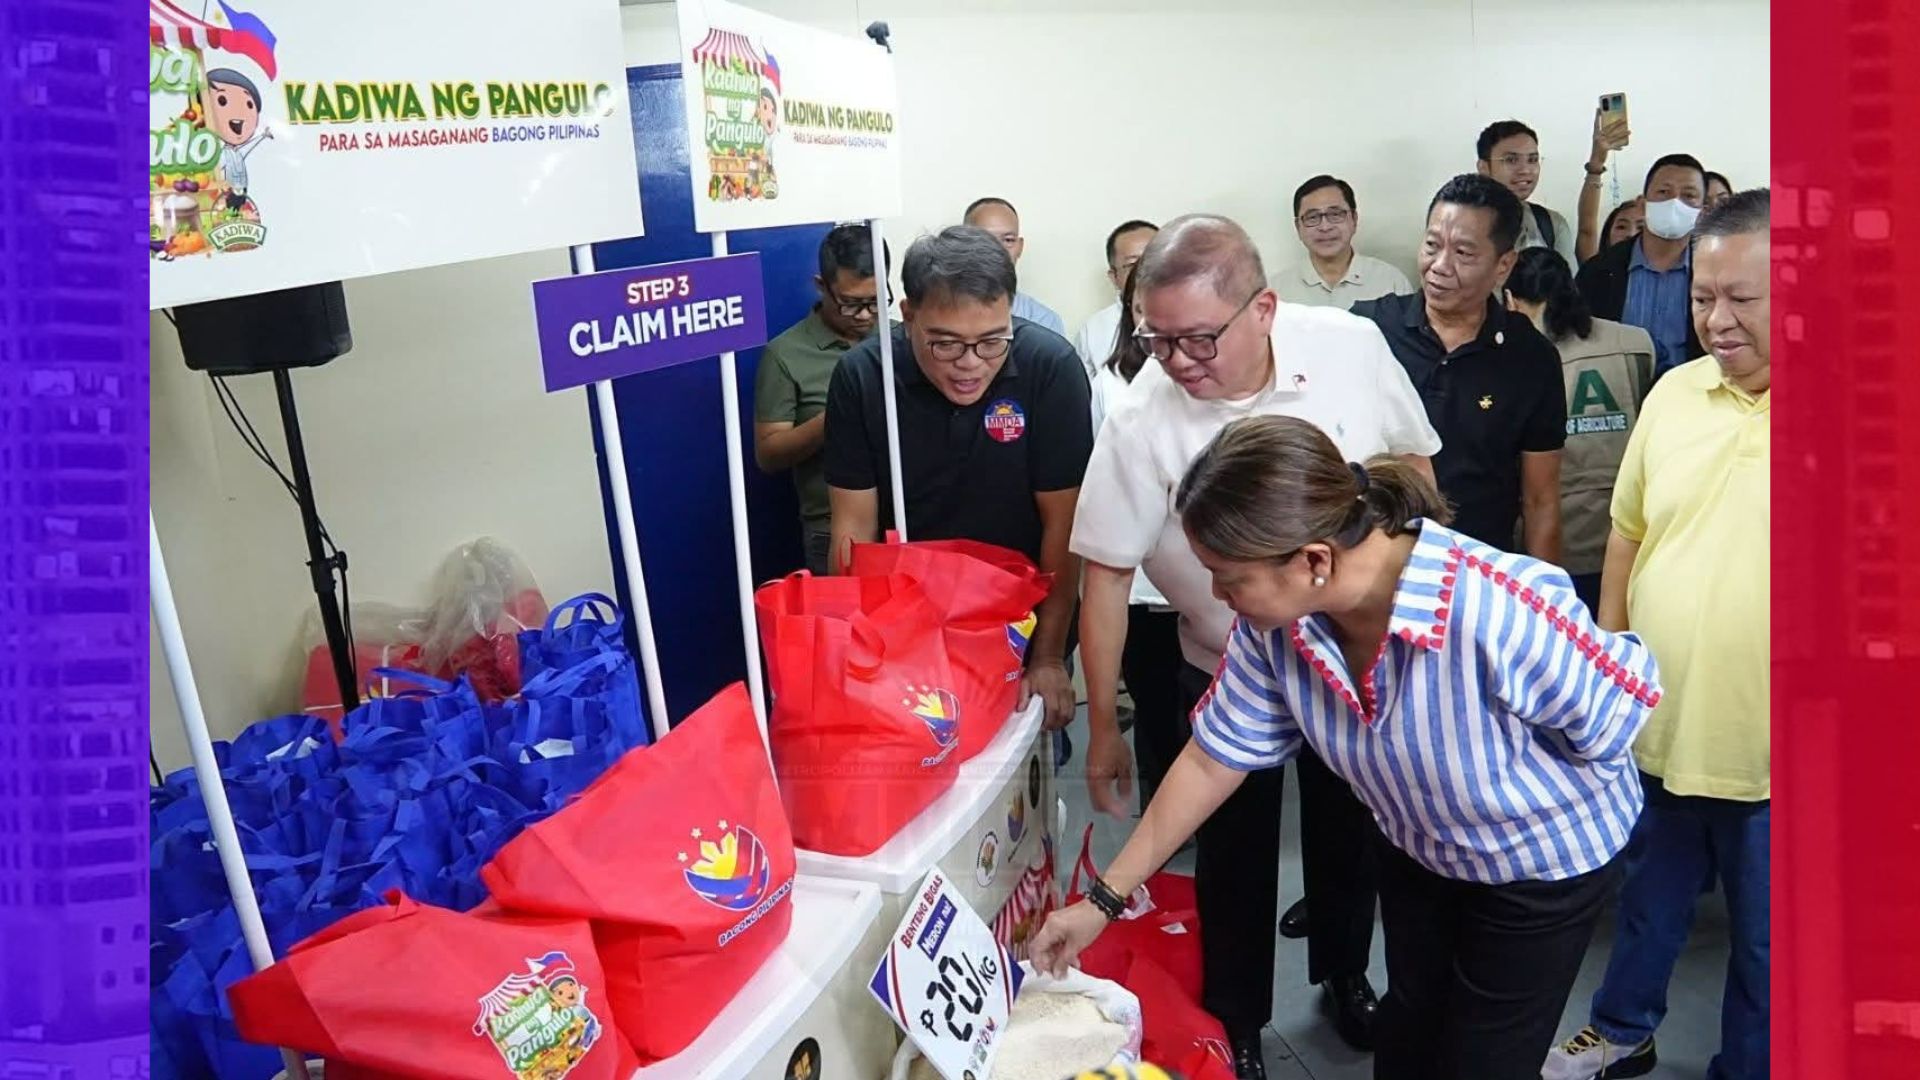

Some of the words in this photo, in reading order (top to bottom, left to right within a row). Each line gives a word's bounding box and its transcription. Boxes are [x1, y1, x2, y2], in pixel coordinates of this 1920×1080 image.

[285, 82, 427, 124] KADIWA
[431, 82, 481, 119] NG
[783, 98, 826, 128] KADIWA
[827, 105, 844, 129] NG
[846, 108, 893, 133] PANGULO
[319, 132, 360, 151] PARA
[364, 131, 384, 149] SA
[388, 126, 489, 149] MASAGANANG
[492, 124, 546, 143] BAGONG
[549, 123, 600, 140] PILIPINAS
[706, 111, 764, 149] Pangulo
[213, 223, 261, 243] KADIWA
[627, 278, 675, 304] STEP
[677, 275, 690, 296] 3
[569, 308, 667, 357] CLAIM
[672, 295, 745, 337] HERE
[1577, 414, 1626, 433] AGRICULTURE
[719, 910, 757, 946] BAGONG
[757, 877, 794, 918] PILIPINAS
[900, 902, 928, 949] BENTENG
[923, 874, 943, 906] BIGAS
[506, 1007, 573, 1070] Pangulo
